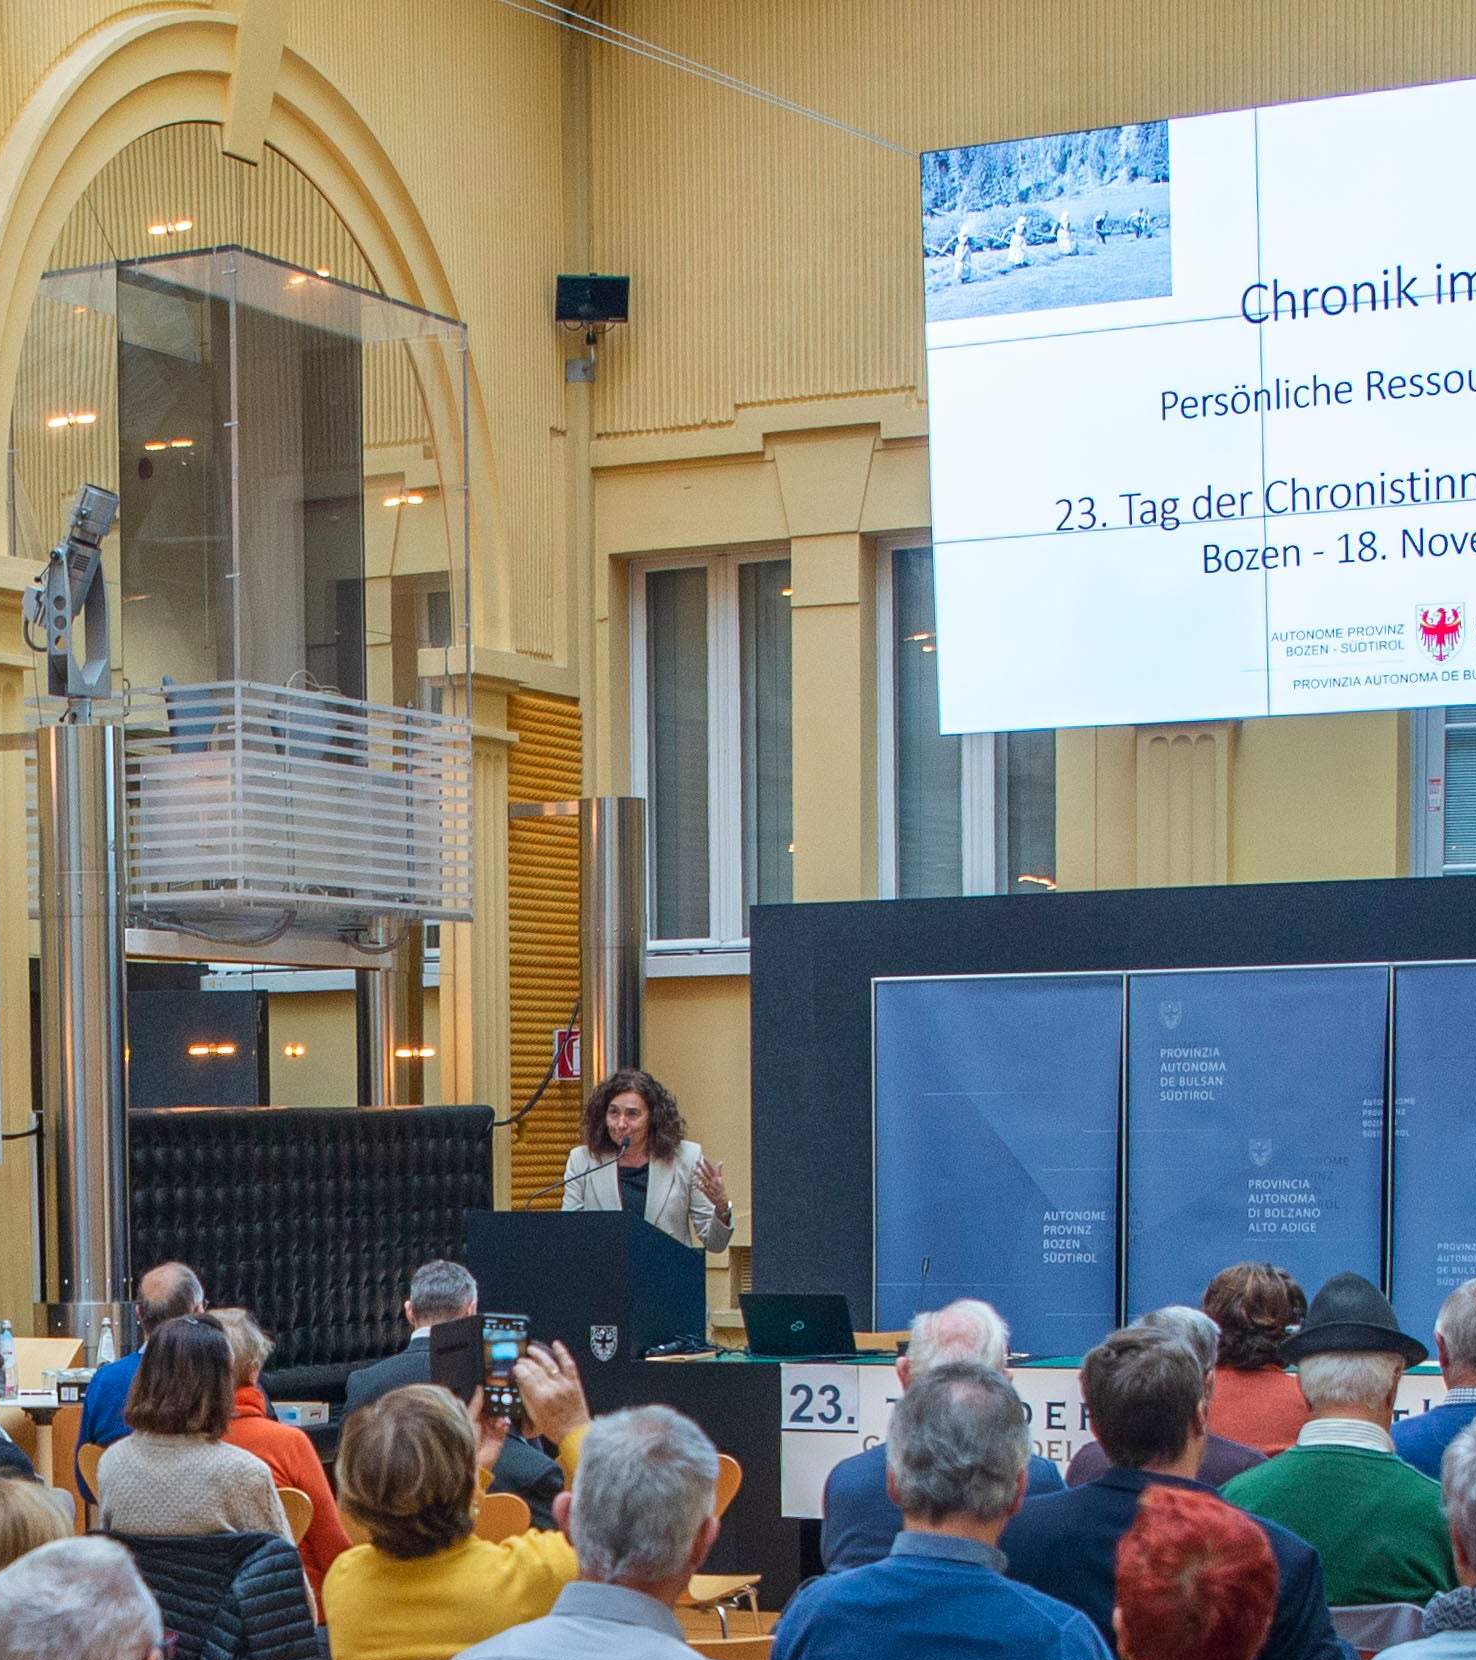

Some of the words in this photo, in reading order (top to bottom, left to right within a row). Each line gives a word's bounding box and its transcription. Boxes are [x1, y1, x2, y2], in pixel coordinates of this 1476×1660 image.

[1241, 265, 1418, 324] Chronik
[1161, 373, 1353, 420] Persönliche
[1055, 496, 1107, 531] 23.
[1119, 492, 1181, 531] Tag
[1192, 484, 1253, 521] der
[1203, 542, 1301, 574] Bozen
[1337, 530, 1387, 565] 18.
[1271, 627, 1343, 643] AUTONOME
[1347, 623, 1405, 638] PROVINZ
[1285, 644, 1329, 658] BOZEN
[1340, 639, 1405, 655] SÜDTIROL
[1293, 676, 1362, 691] PROVINZIA
[1364, 671, 1439, 687] AUTONOMA
[1441, 669, 1460, 683] DE
[1159, 1047, 1221, 1059] PROVINZIA
[1159, 1062, 1227, 1073] AUTONOMA
[1159, 1076, 1176, 1088] DE
[1179, 1075, 1224, 1087] BULSAN
[1159, 1088, 1216, 1101] SÜDTIROL
[1248, 1178, 1311, 1190] PROVINCIA
[1248, 1193, 1316, 1204] AUTONOMA
[1043, 1210, 1107, 1222] AUTONOME
[1248, 1207, 1260, 1219] DI
[1263, 1207, 1321, 1219] BOLZANO
[1042, 1224, 1093, 1236] PROVINZ
[1247, 1222, 1277, 1233] ALTO
[1279, 1222, 1317, 1233] ADIGE
[1042, 1238, 1081, 1250] BOZEN
[1042, 1252, 1098, 1264] SÜDTIROL
[789, 1383, 855, 1425] 23.
